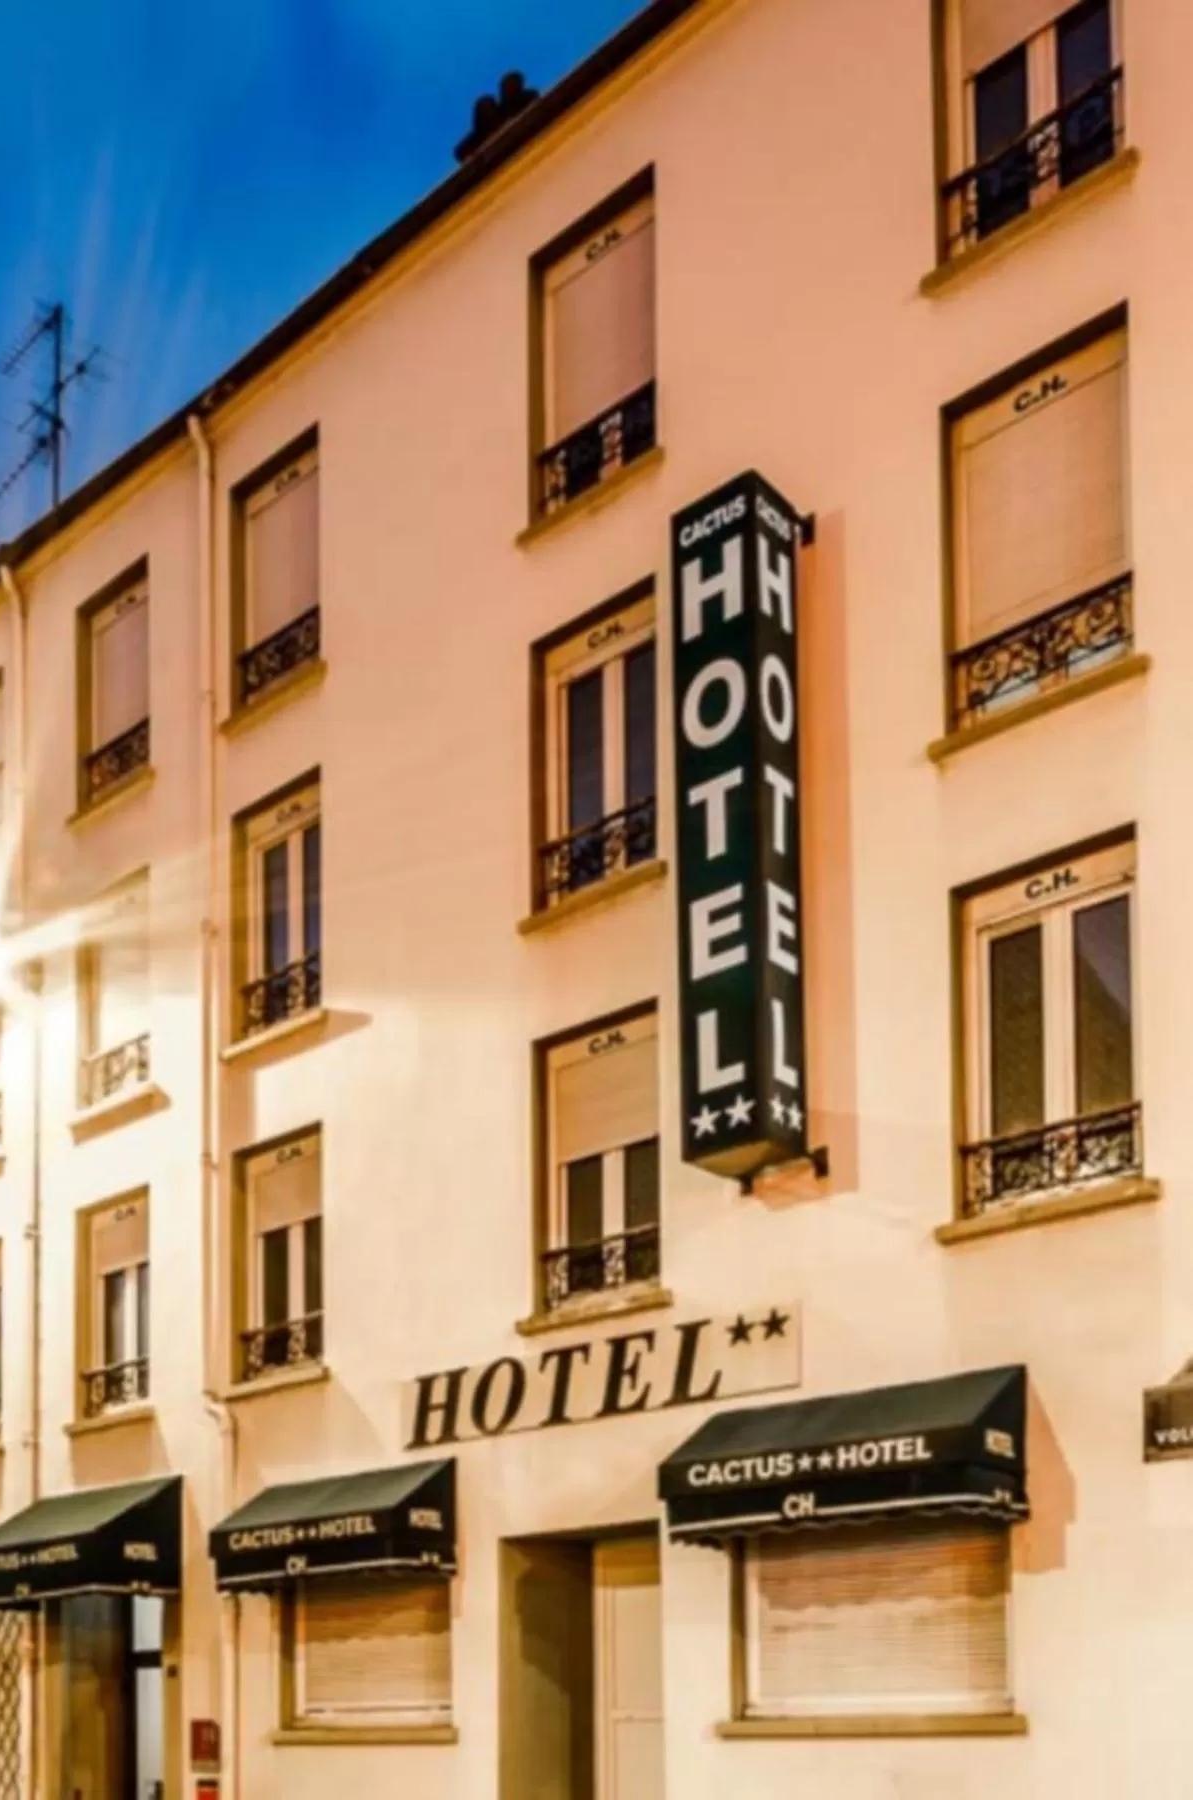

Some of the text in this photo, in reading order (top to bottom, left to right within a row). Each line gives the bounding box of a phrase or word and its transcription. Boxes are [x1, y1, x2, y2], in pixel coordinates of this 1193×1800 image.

[679, 494, 747, 548] CACTUS
[681, 533, 748, 1095] HOTEL
[756, 531, 799, 1090] HOTEL
[1025, 868, 1080, 899] C.H.
[403, 1318, 723, 1452] HOTEL
[1154, 1425, 1193, 1445] VOL
[687, 1436, 933, 1487] CACTUS HOTEL
[782, 1492, 817, 1519] CH
[228, 1515, 377, 1550] CACTUS HOTEL
